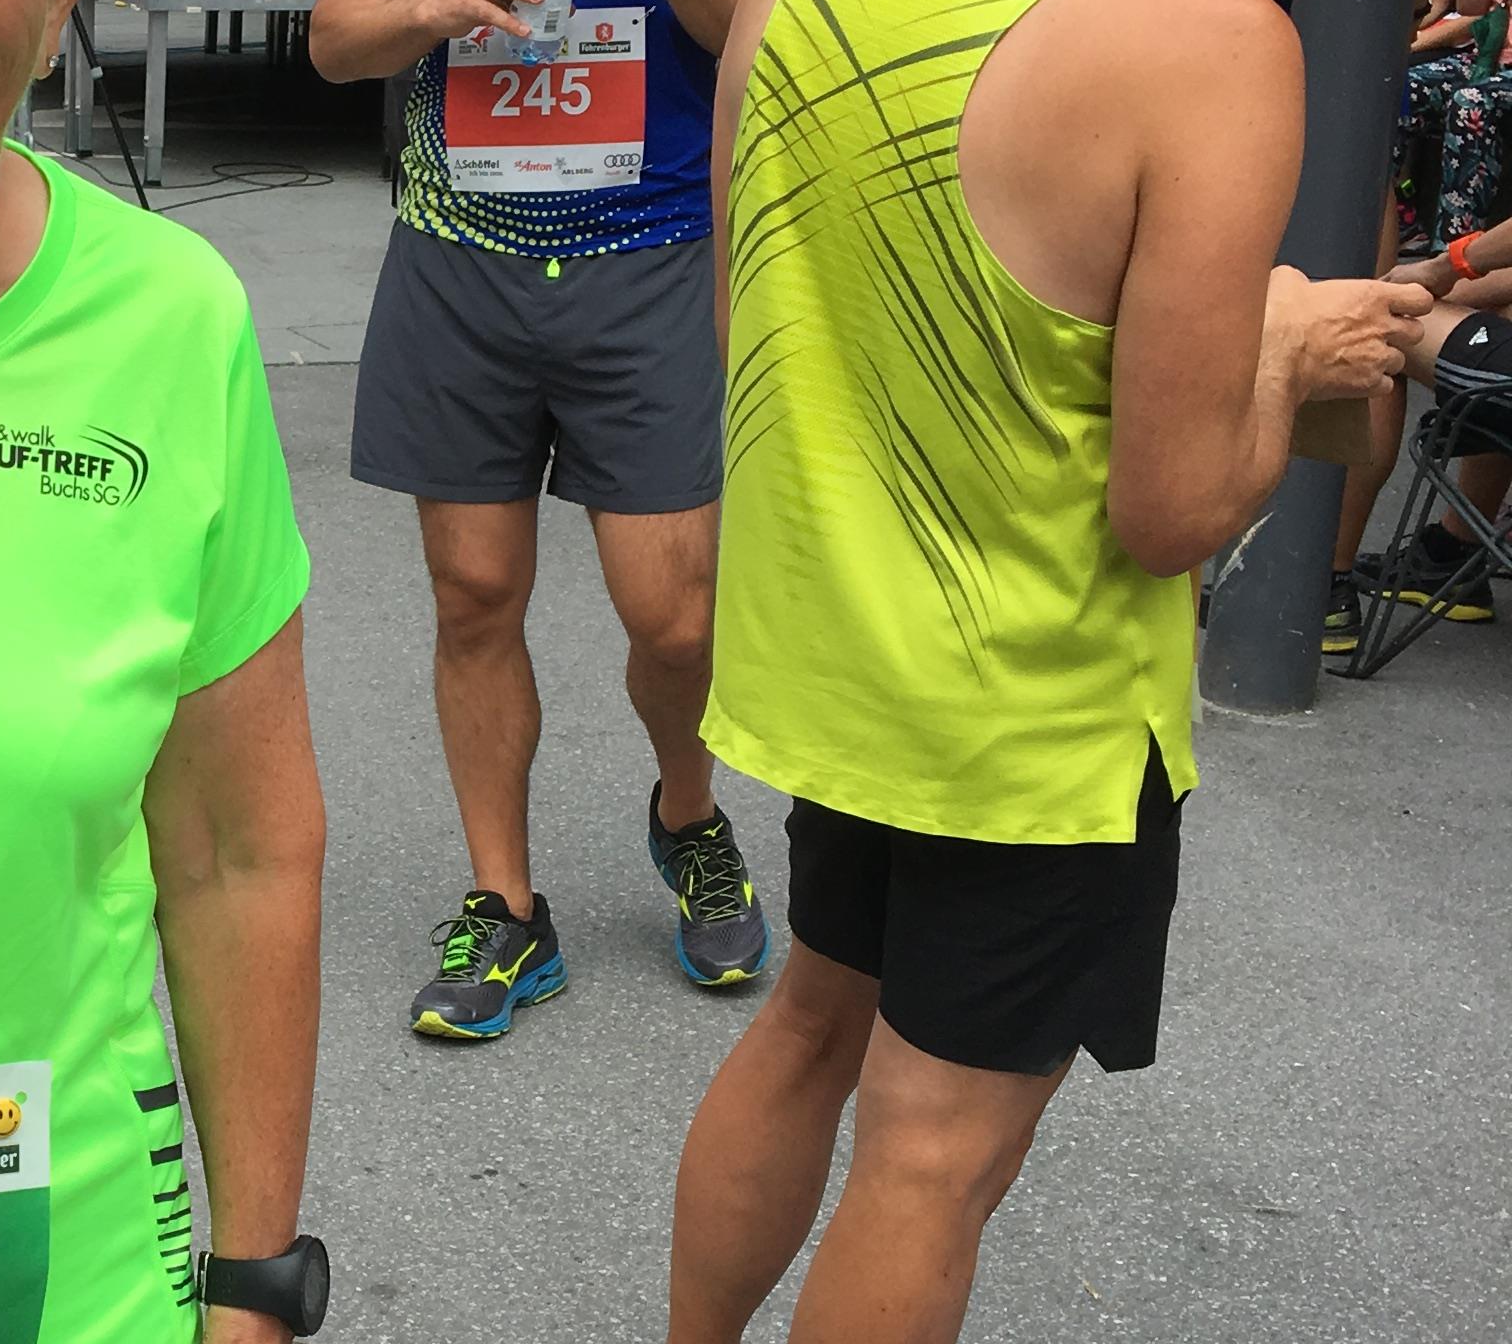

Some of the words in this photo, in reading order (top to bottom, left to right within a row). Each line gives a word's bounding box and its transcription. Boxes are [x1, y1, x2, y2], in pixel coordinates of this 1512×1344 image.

[490, 67, 592, 118] 245
[10, 424, 56, 448] walk
[40, 474, 89, 501] Buchs
[93, 482, 120, 506] SG
